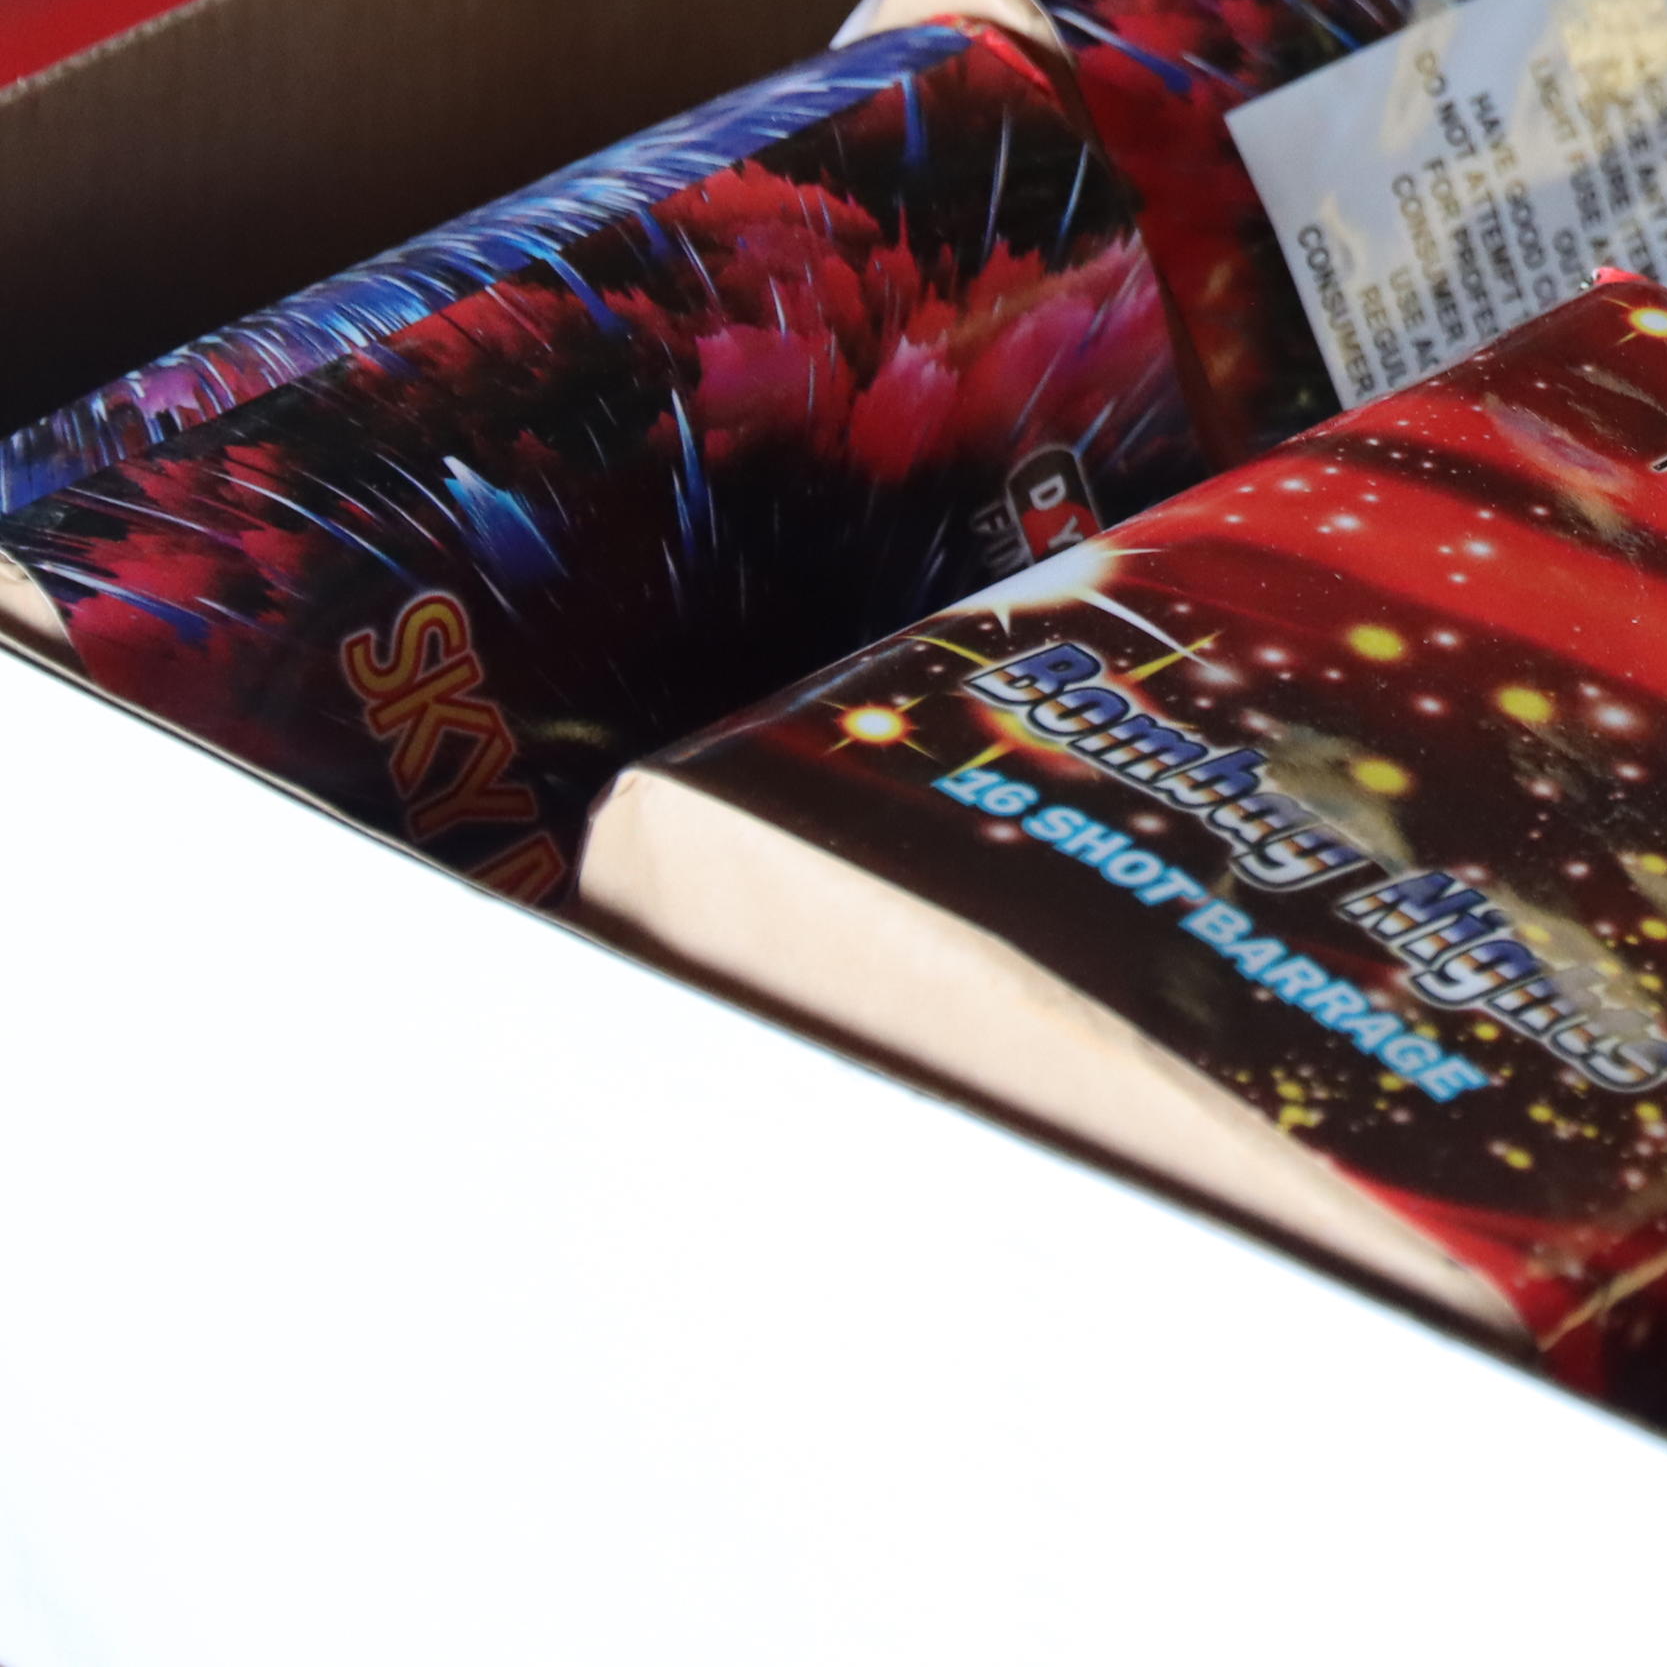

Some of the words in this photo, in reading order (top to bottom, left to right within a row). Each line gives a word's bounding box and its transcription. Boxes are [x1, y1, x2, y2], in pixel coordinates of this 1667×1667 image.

[1388, 170, 1469, 347] CONSUMER
[1421, 156, 1462, 222] FOR
[1433, 97, 1478, 164] NOT
[1460, 167, 1525, 305] ATTEMPT
[1468, 88, 1518, 172] HAVE
[1499, 178, 1551, 271] GOOD
[1293, 220, 1377, 402] CONSUMER
[1386, 265, 1429, 332] USE
[341, 590, 538, 842] SKY
[964, 640, 1372, 894] Bombay
[931, 764, 1020, 823] 16
[1017, 794, 1201, 913] SHOT
[1179, 888, 1491, 1103] BARRAGE
